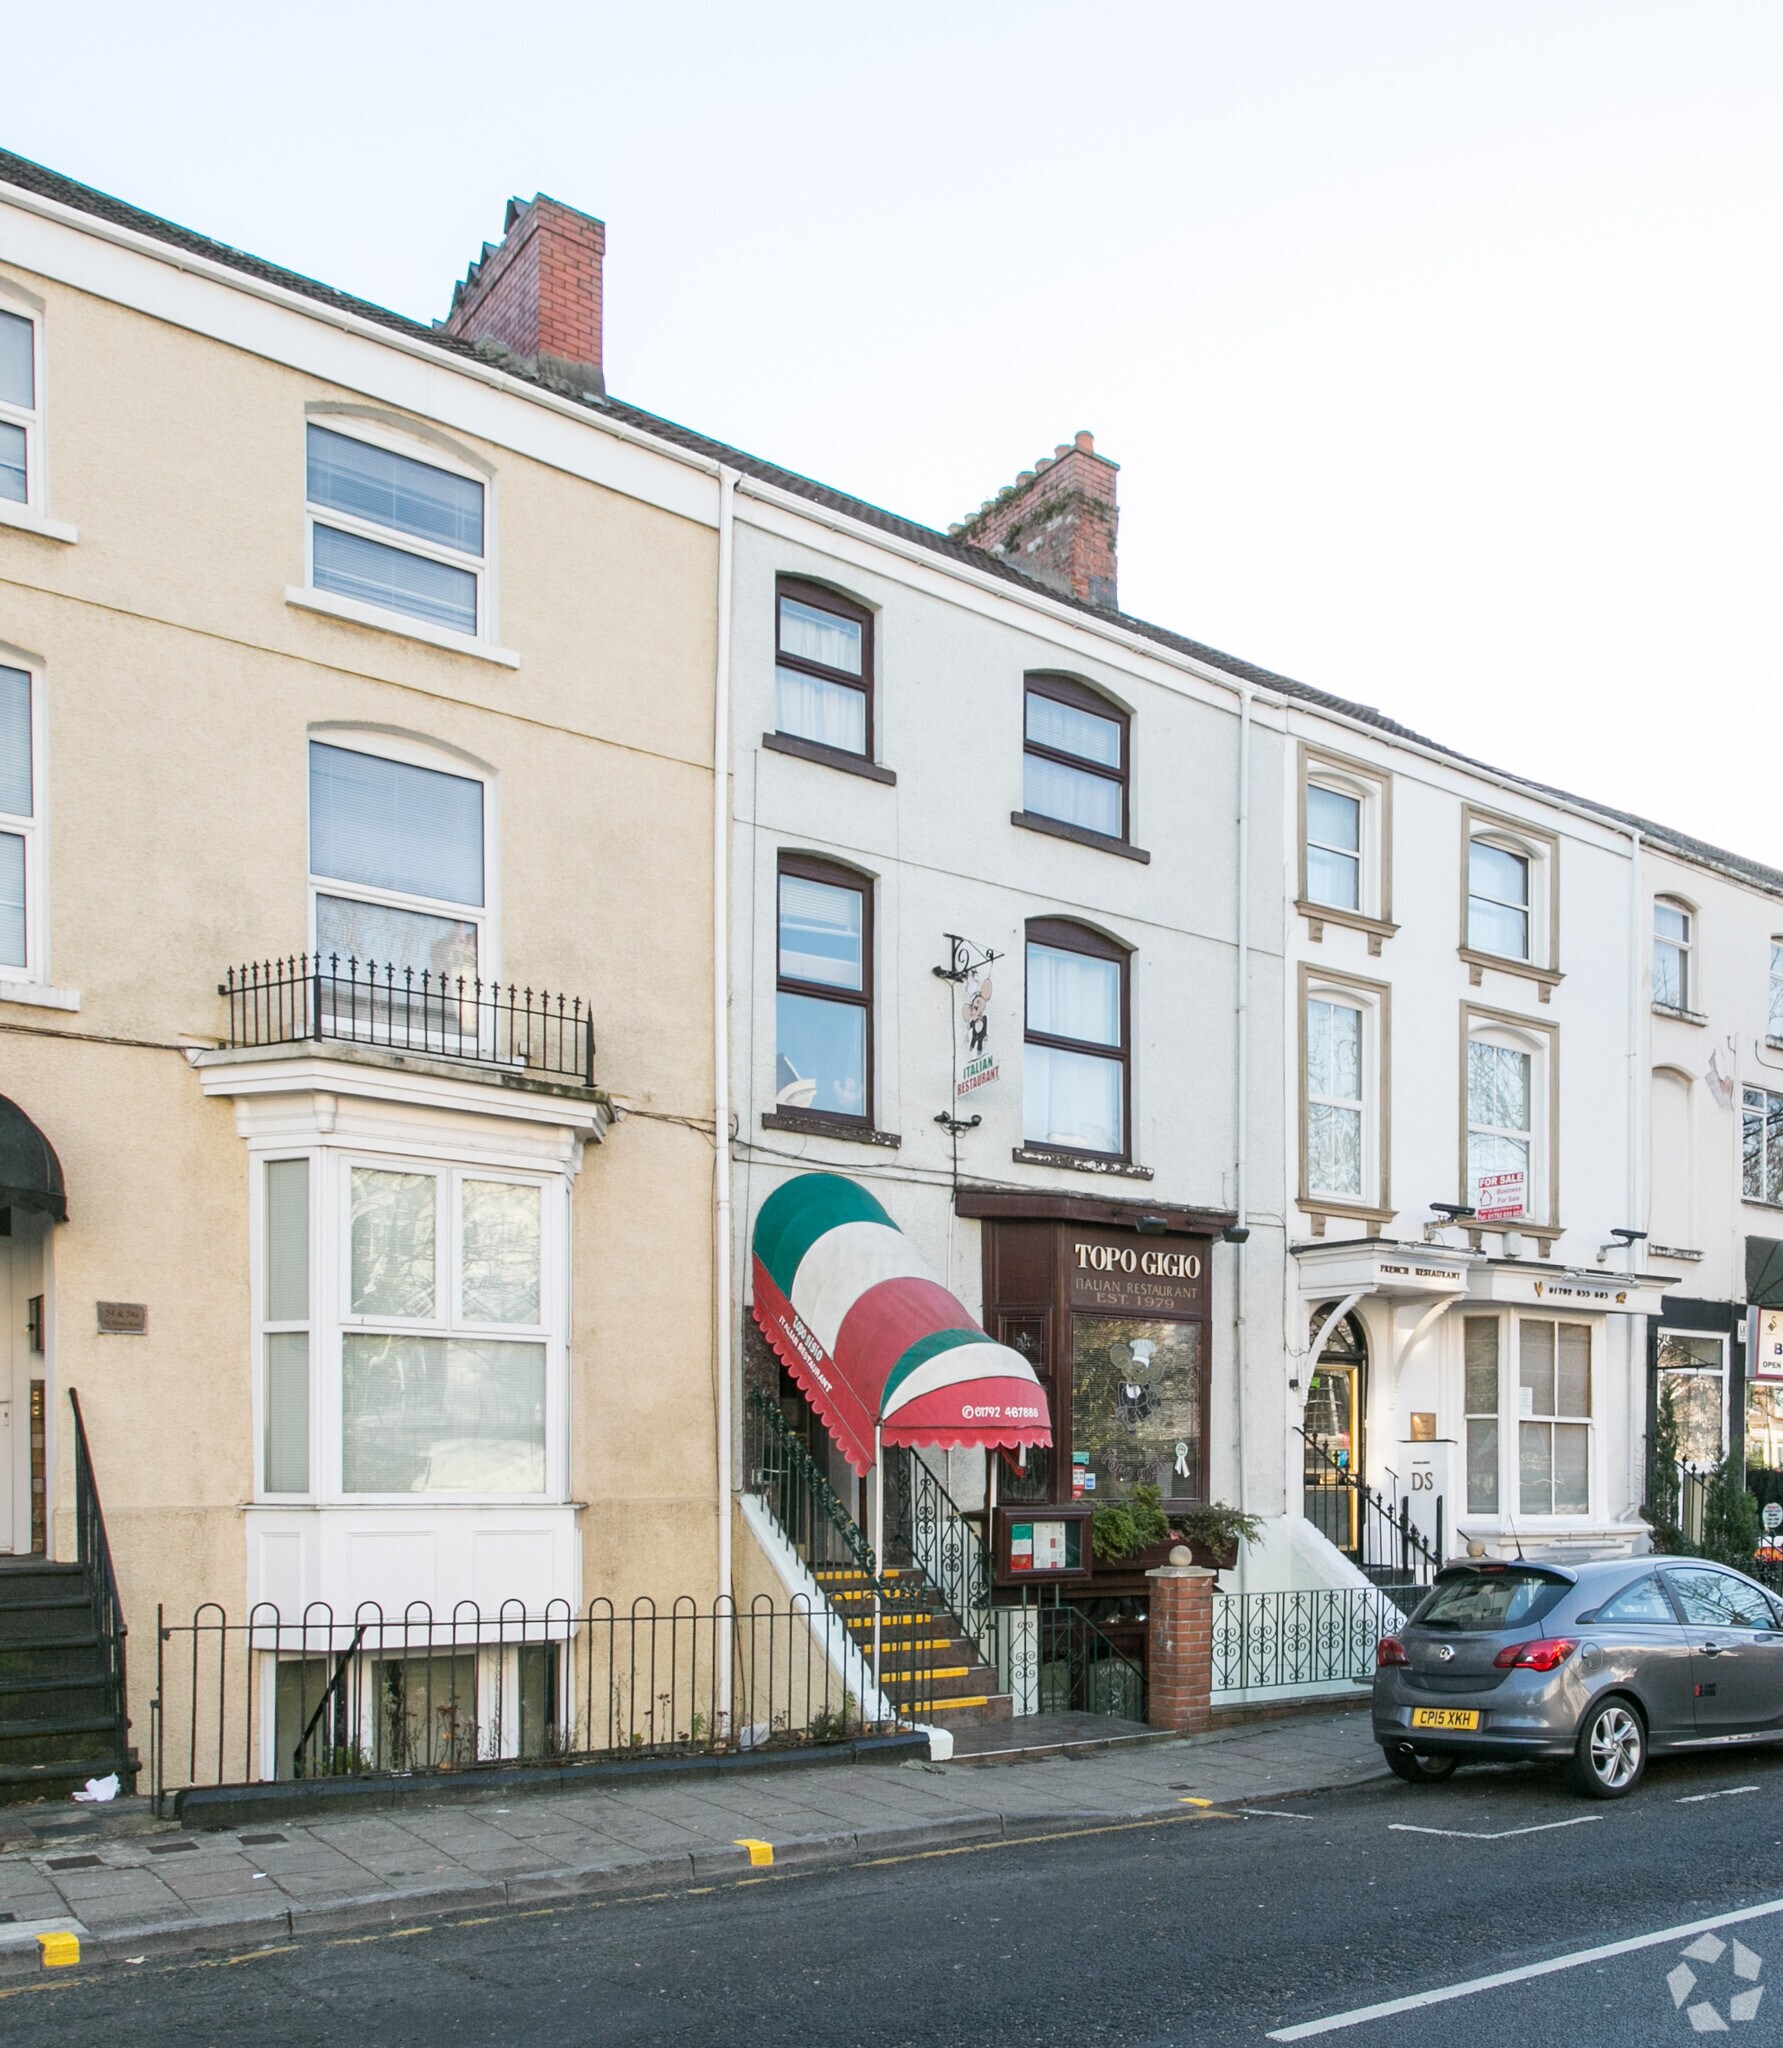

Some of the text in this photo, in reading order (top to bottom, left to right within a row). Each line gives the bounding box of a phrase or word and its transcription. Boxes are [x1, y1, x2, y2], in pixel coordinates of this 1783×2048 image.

[963, 1055, 993, 1080] ITALIAN
[957, 1065, 999, 1096] RESTAURANT
[1479, 1172, 1524, 1188] FOR SALE
[1497, 1187, 1522, 1195] Business
[1075, 1244, 1201, 1279] TOPO GIGIO
[1380, 1264, 1461, 1280] FRENCH RESTAURANT
[1076, 1278, 1198, 1299] ITALIAN RESTAURANT
[1549, 1287, 1572, 1296] 01792
[1096, 1292, 1175, 1309] EST. 1979
[779, 1315, 833, 1392] ITALIAN RESTAURANT
[1763, 1361, 1781, 1369] OPEN
[975, 1406, 1000, 1418] 01792
[1411, 1472, 1433, 1491] DS
[1420, 1711, 1470, 1726] CP15 XKH
